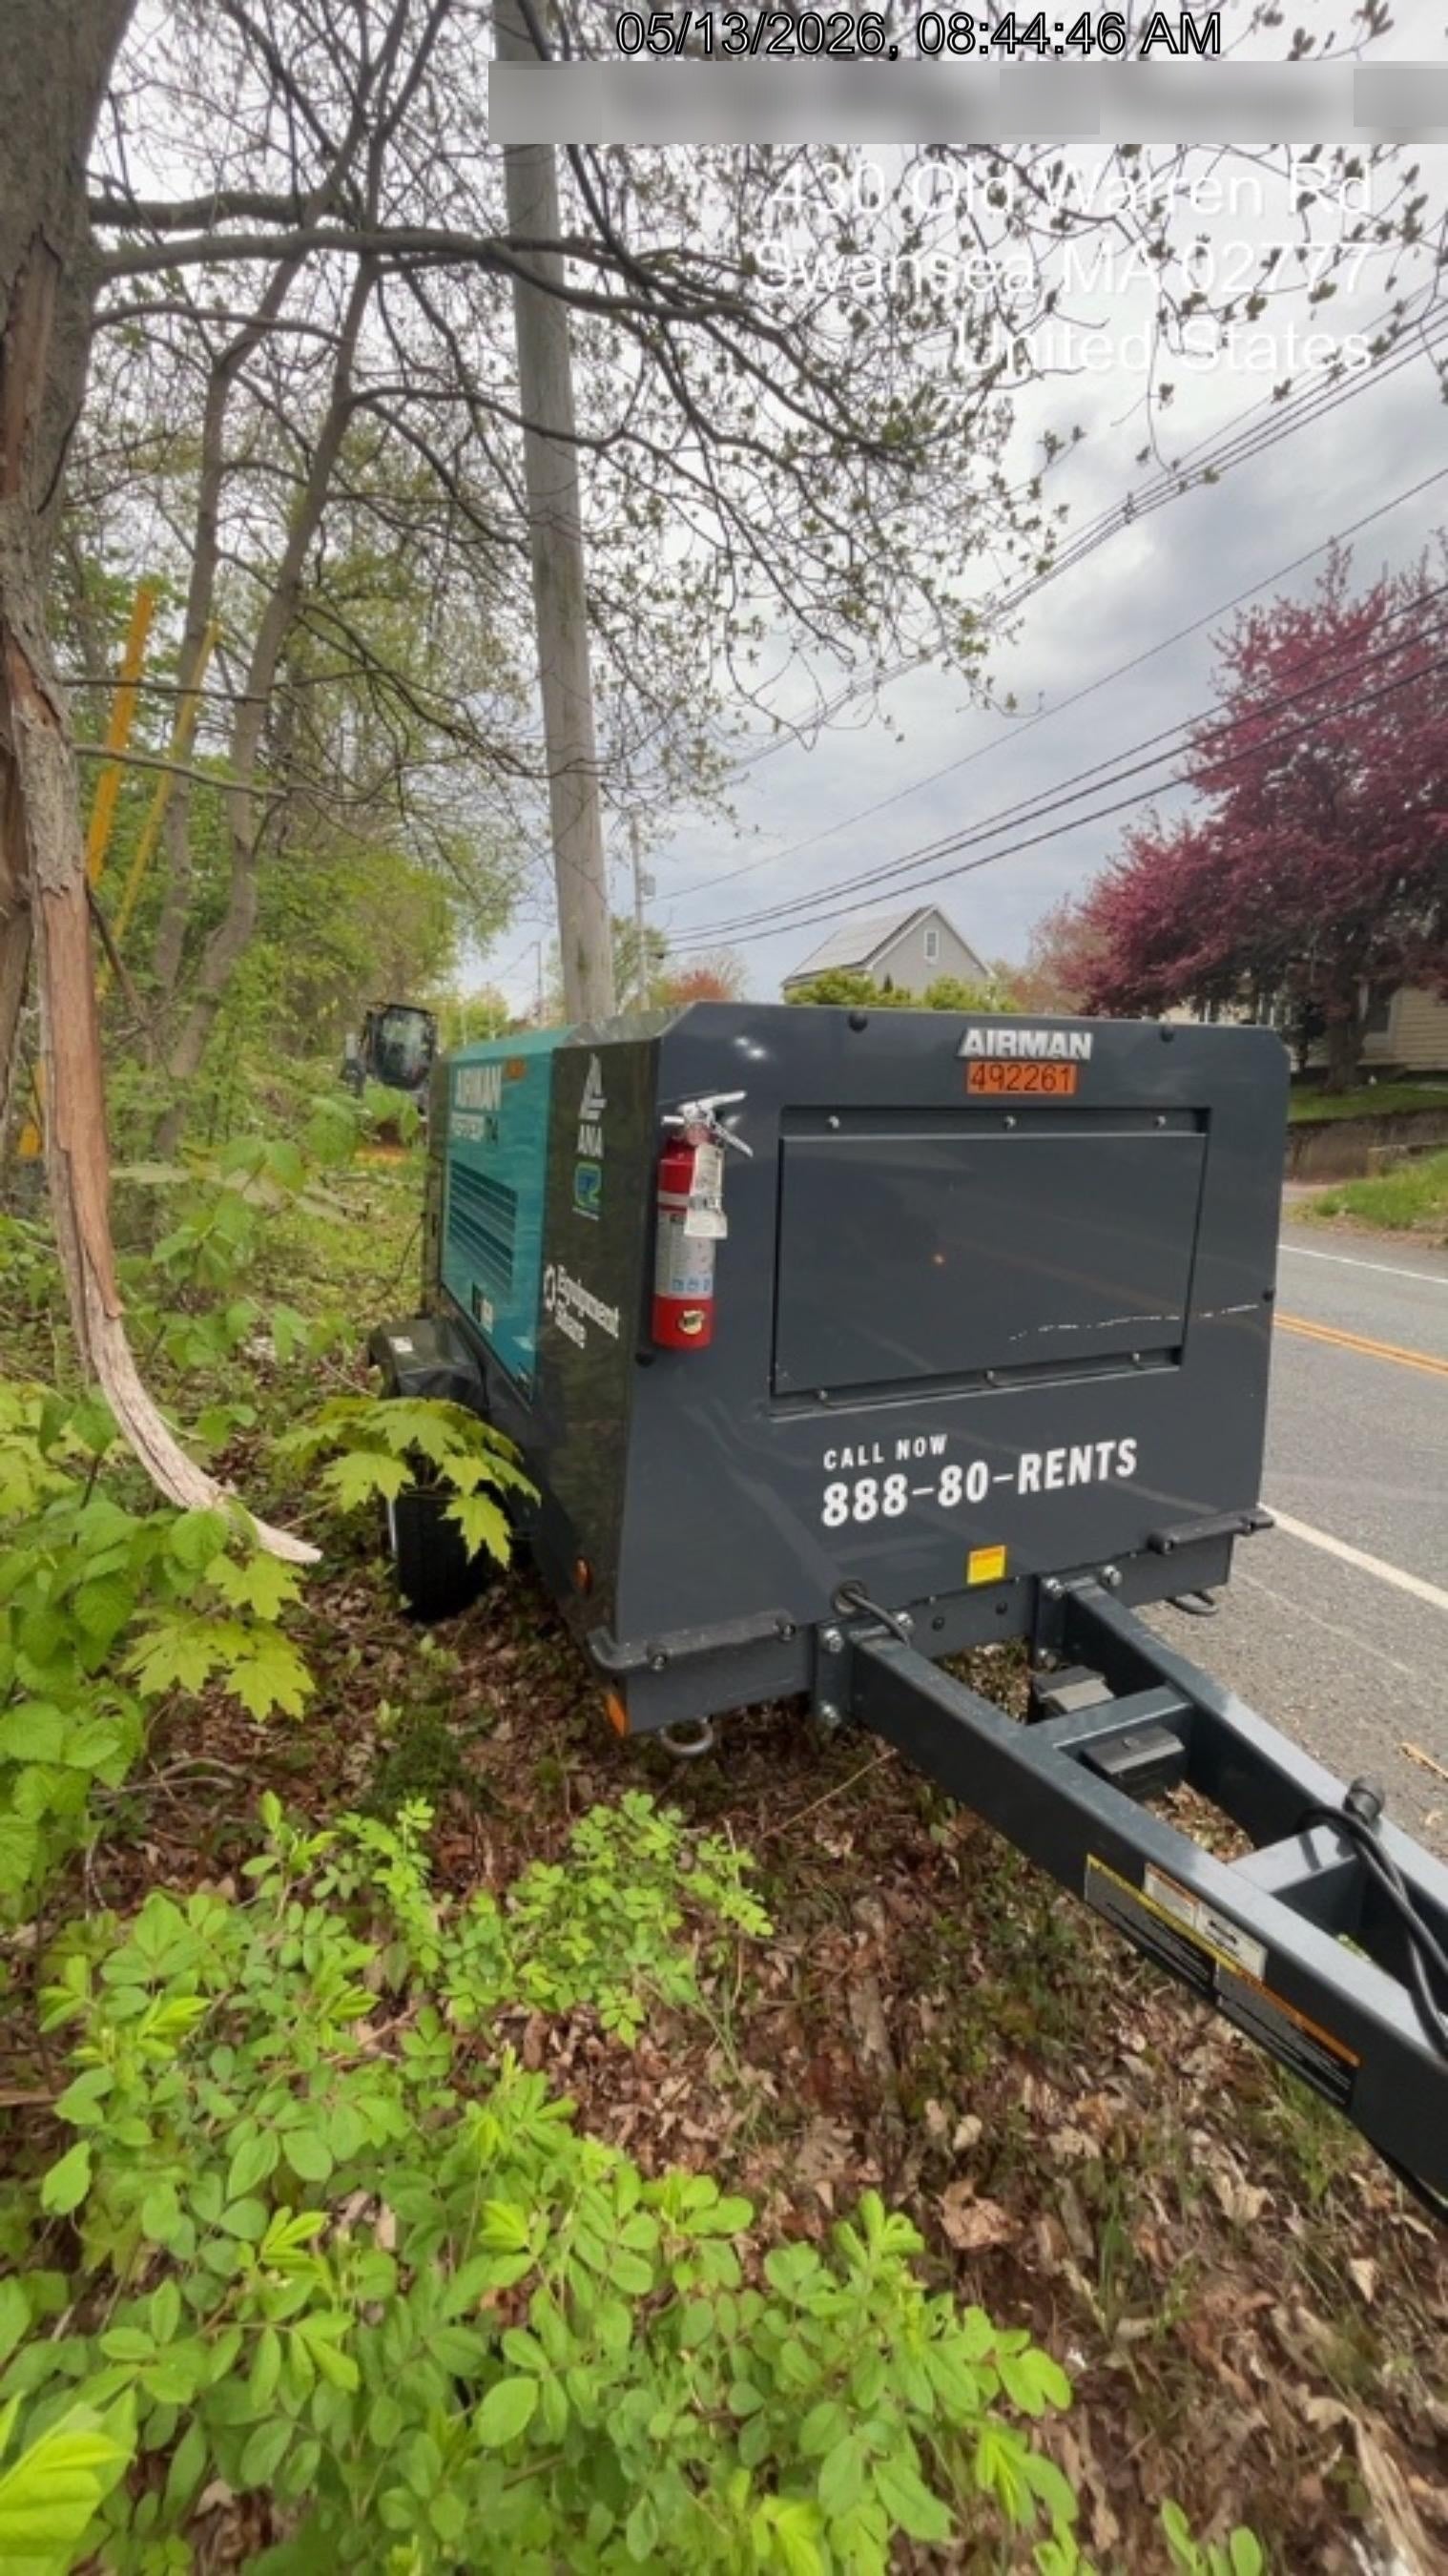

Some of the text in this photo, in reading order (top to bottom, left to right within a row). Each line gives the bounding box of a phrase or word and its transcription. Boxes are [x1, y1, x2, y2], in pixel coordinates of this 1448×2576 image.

[958, 1028, 1093, 1061] AIRMAN
[970, 1063, 1071, 1092] 492261
[823, 1433, 948, 1470] CALL NOW
[820, 1437, 1138, 1527] 888-80-RENTS
